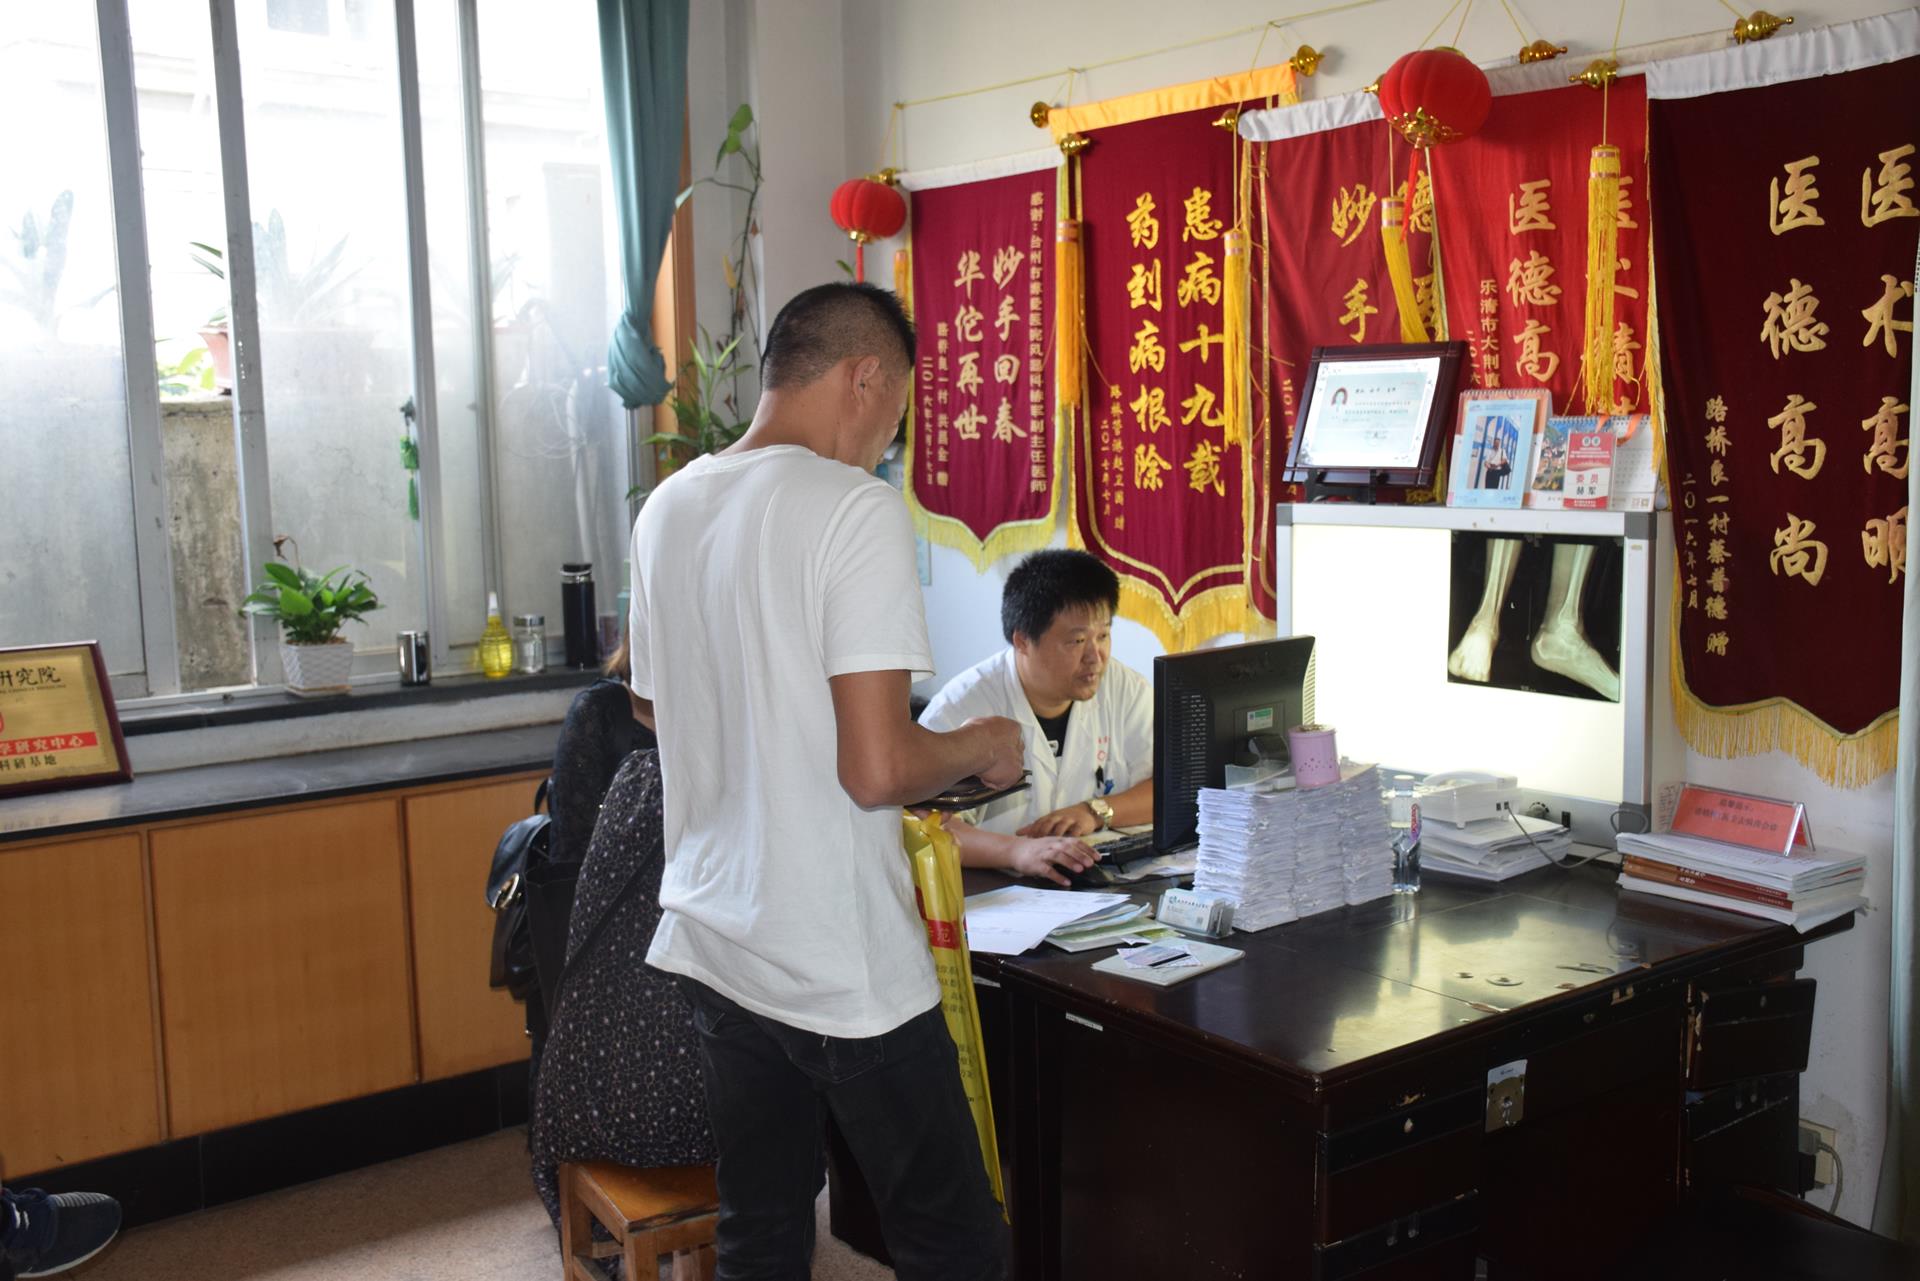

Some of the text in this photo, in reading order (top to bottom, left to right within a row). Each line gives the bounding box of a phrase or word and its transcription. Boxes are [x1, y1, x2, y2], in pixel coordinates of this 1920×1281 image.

[953, 250, 988, 442] 华佗再世
[993, 245, 1028, 444] 妙手回春
[1127, 192, 1172, 492] 药到病根除
[1178, 187, 1227, 498] 患病十九载
[1331, 184, 1378, 344] 妙手
[1760, 155, 1830, 587] 医德高尚
